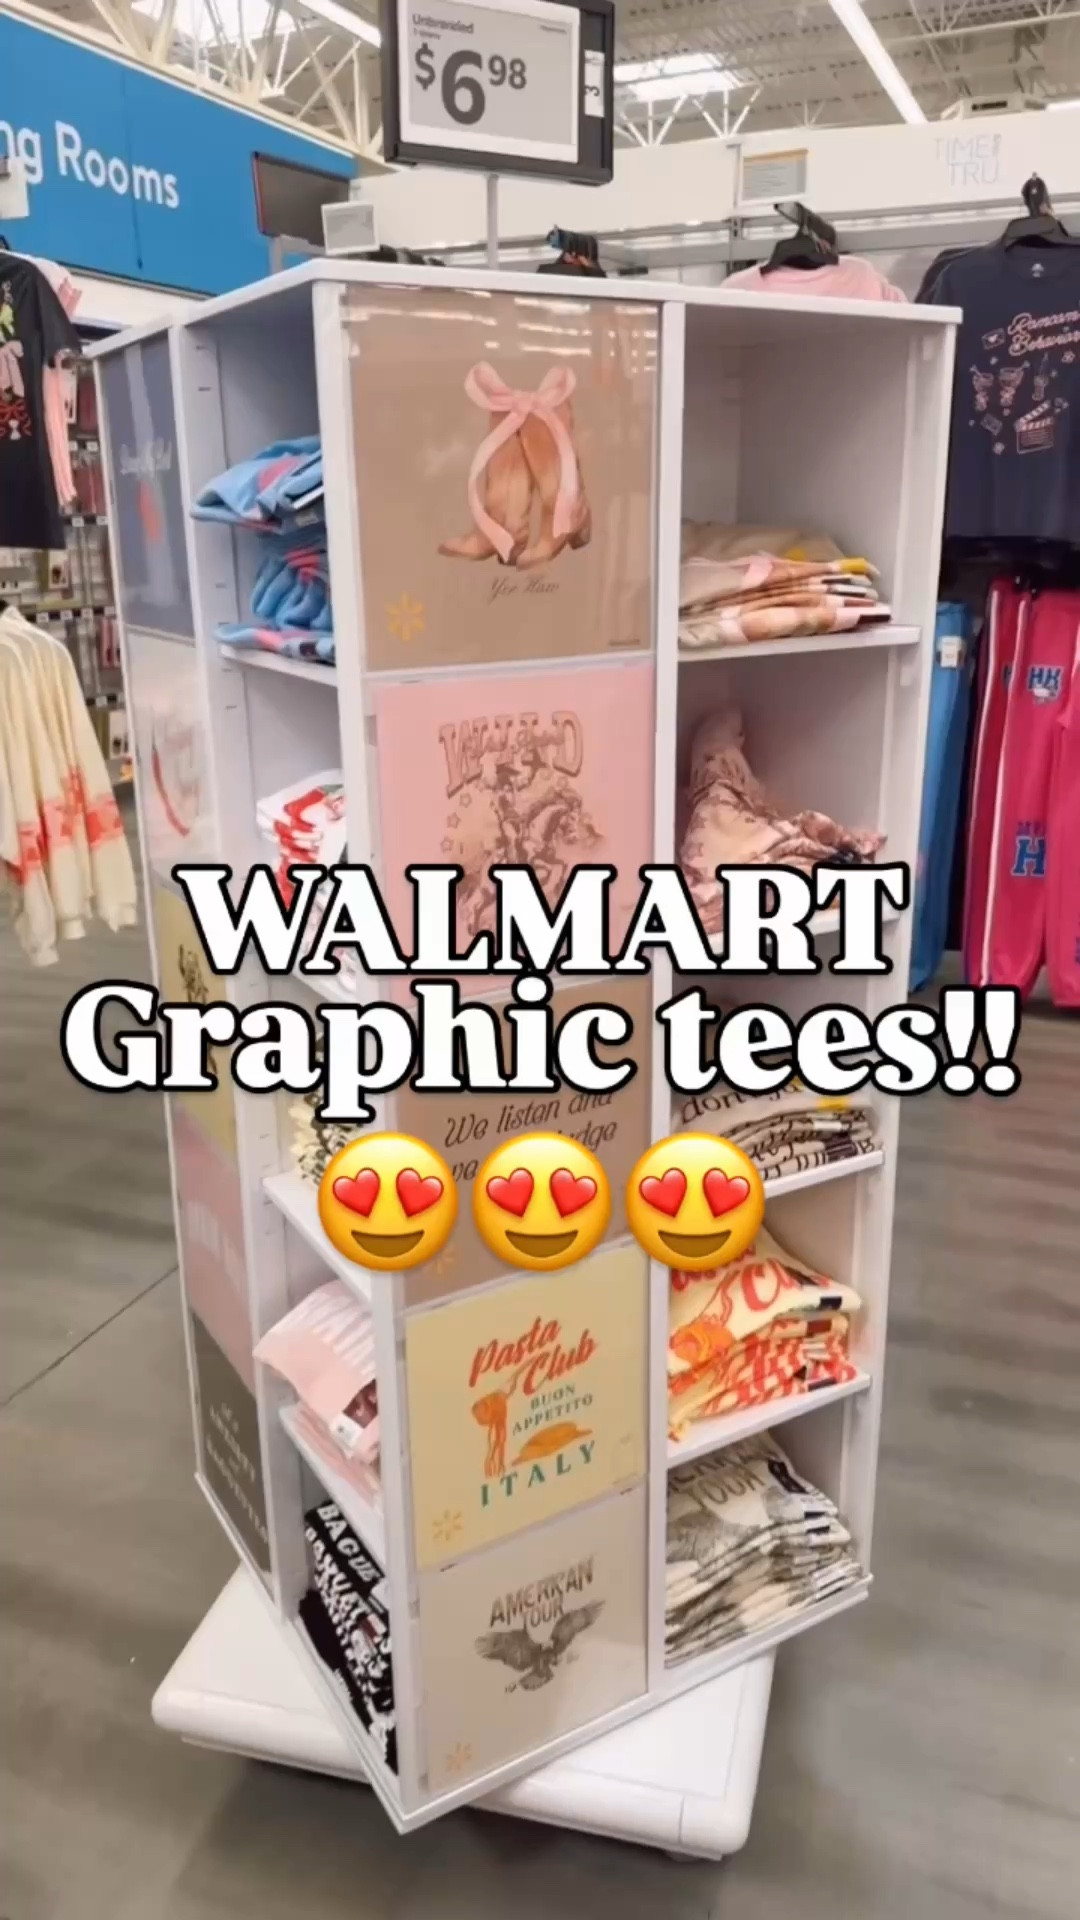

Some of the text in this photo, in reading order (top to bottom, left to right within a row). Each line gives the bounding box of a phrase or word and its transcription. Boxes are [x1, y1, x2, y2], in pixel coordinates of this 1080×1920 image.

[55, 119, 179, 209] Rooms
[444, 1113, 489, 1149] We
[496, 1100, 561, 1134] listen
[468, 1316, 562, 1388] Pasta
[522, 1328, 598, 1396] Club
[512, 1394, 594, 1436] APPETITO
[530, 1383, 576, 1410] BUON
[480, 1440, 596, 1508] ITALY
[522, 1597, 566, 1629] TOUR
